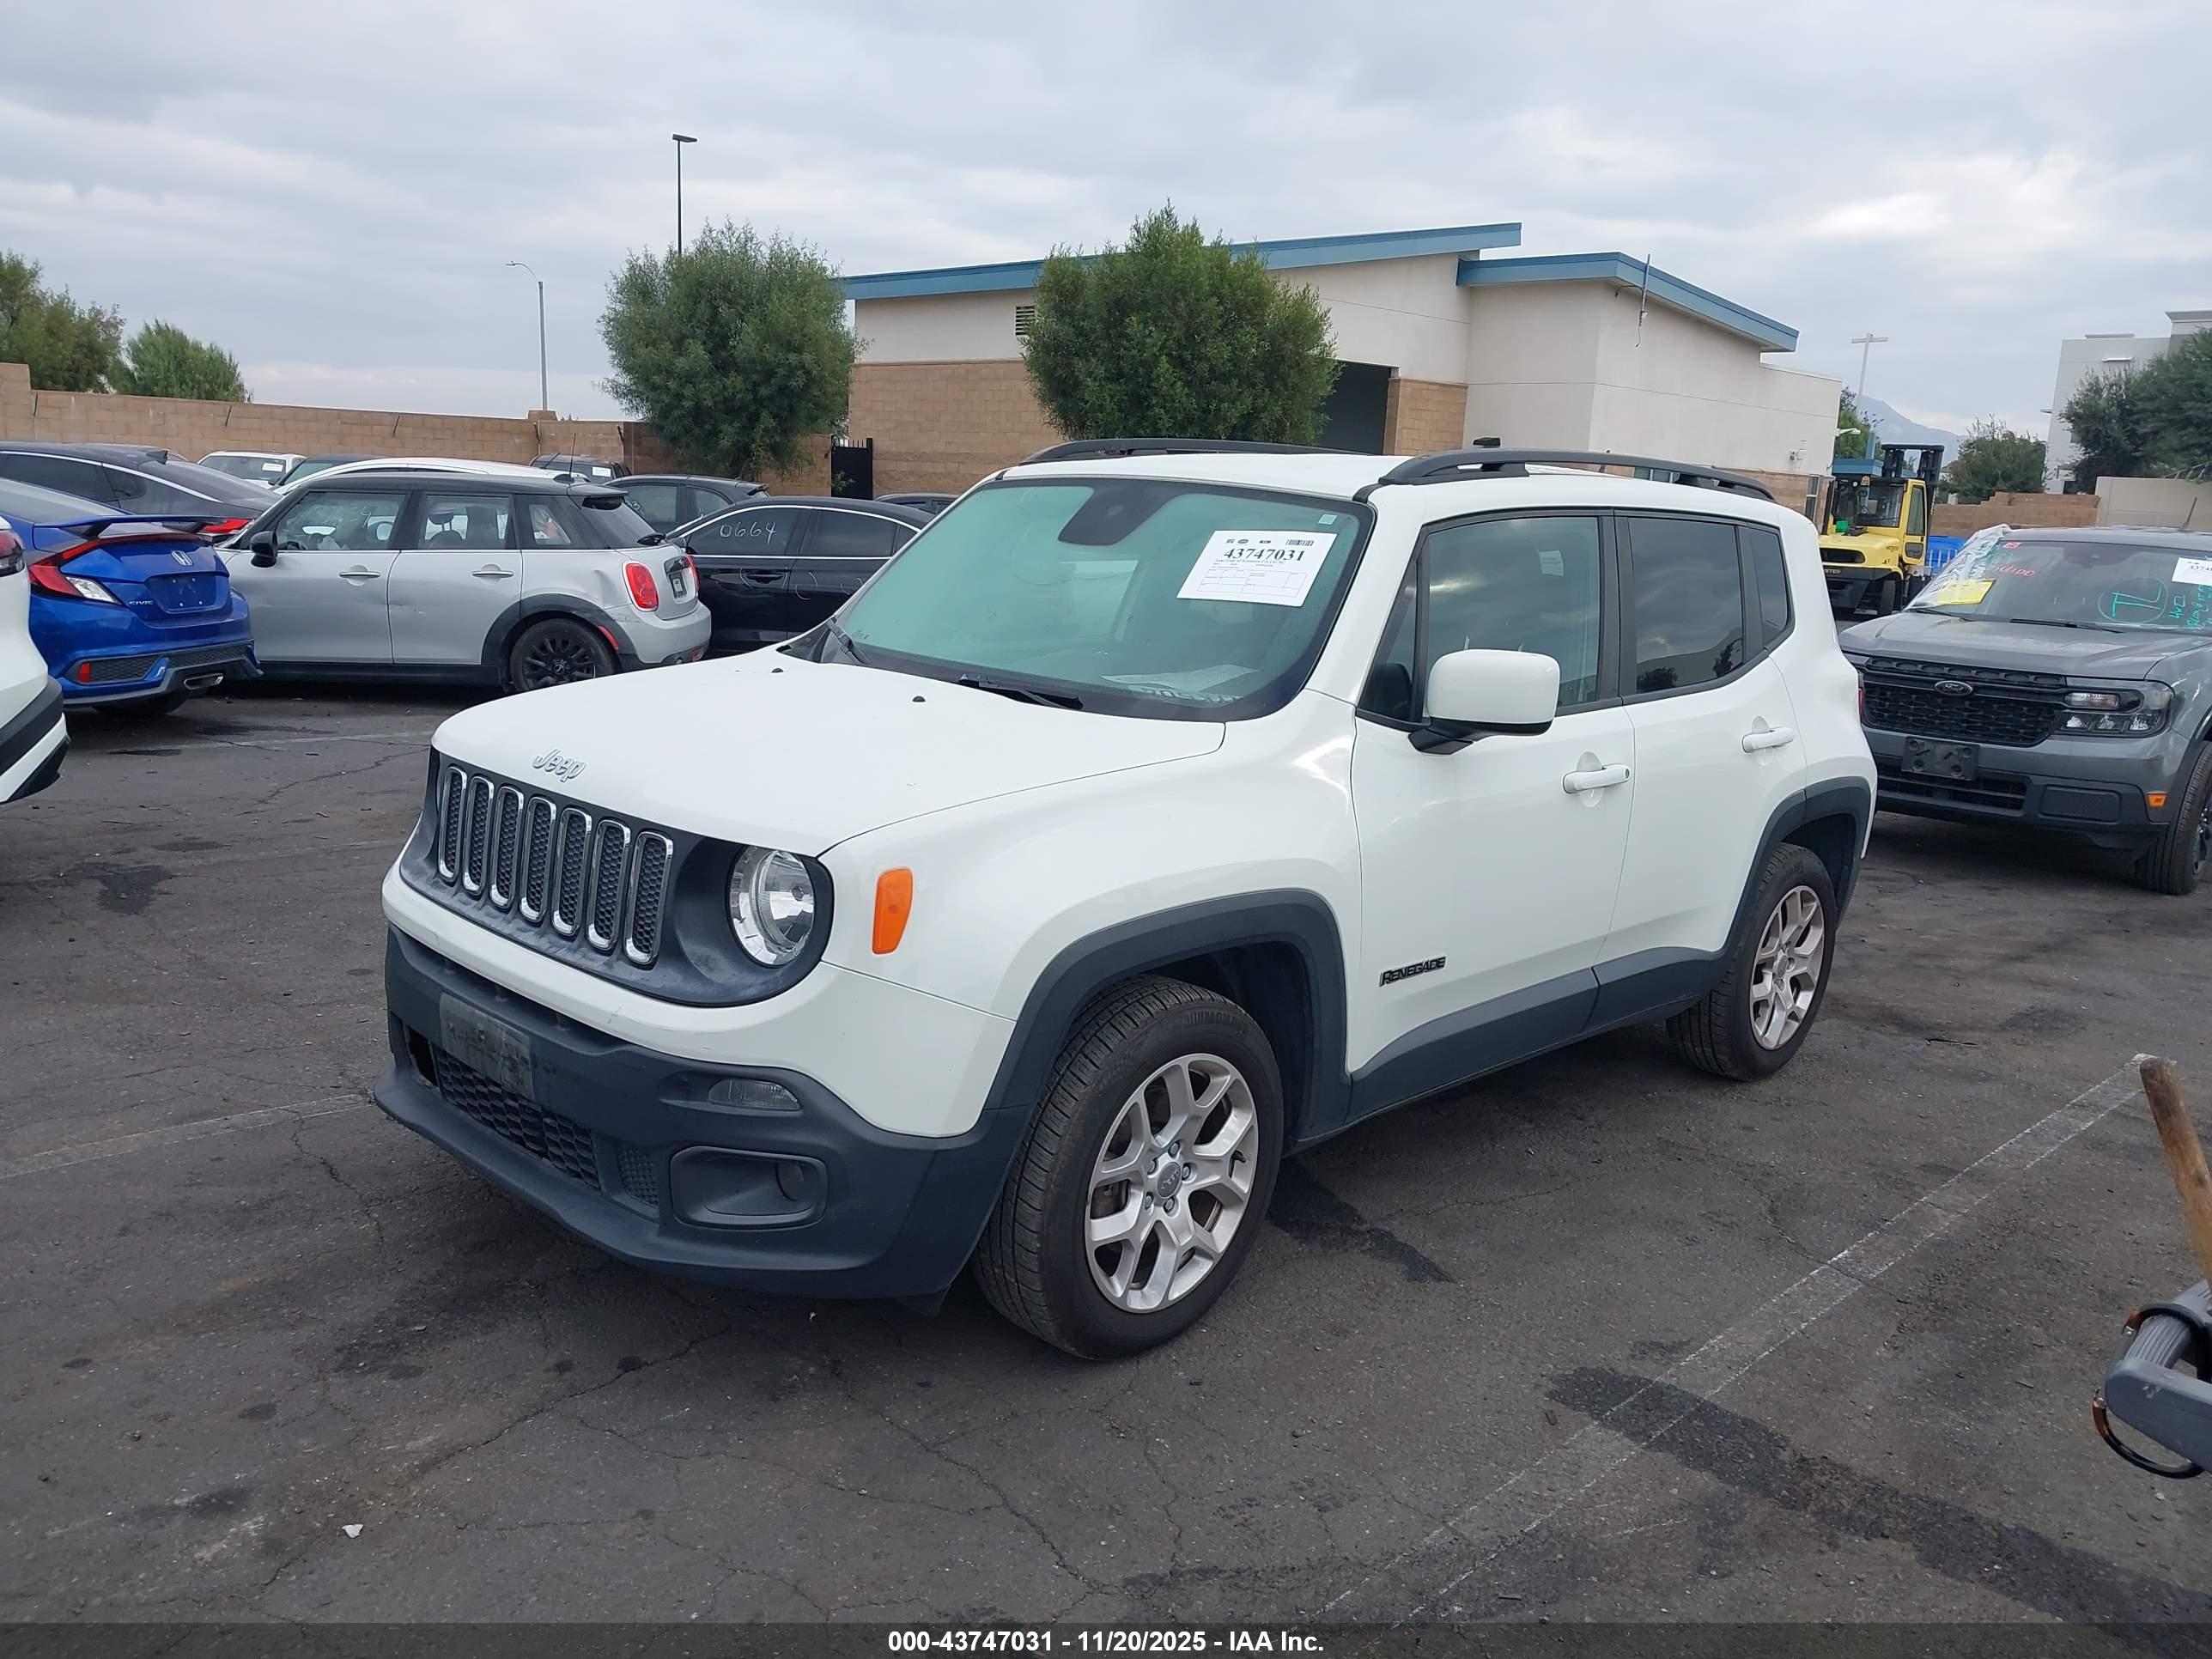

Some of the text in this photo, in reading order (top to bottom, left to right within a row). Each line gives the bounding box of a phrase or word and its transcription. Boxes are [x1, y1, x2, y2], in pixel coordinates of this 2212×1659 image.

[720, 521, 776, 545] 0664
[1224, 548, 1305, 562] 43747031
[532, 749, 586, 783] Jeep
[1379, 956, 1447, 988] RENEGADE
